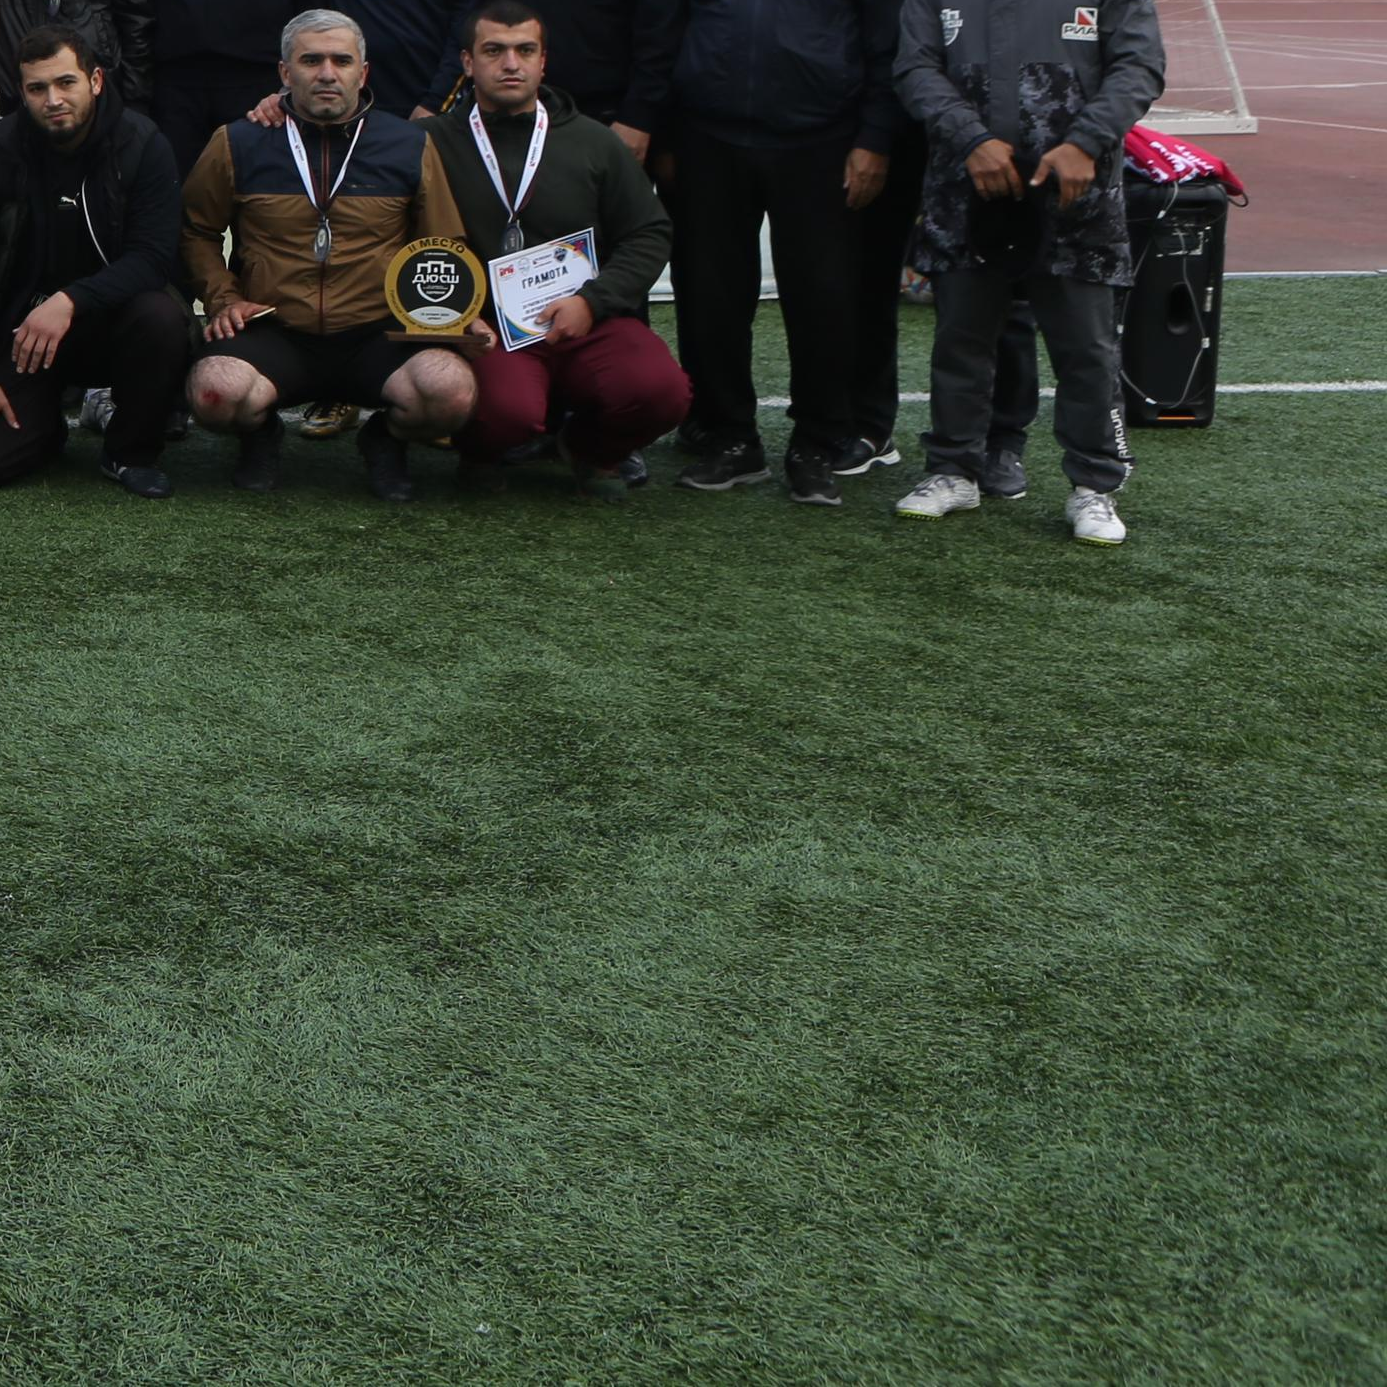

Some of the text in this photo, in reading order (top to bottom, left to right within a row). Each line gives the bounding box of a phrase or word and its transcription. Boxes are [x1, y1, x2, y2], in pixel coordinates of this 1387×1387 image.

[420, 237, 465, 254] МЕСТО
[412, 274, 459, 284] ДЮСШ
[522, 265, 569, 289] ГРАМОТА
